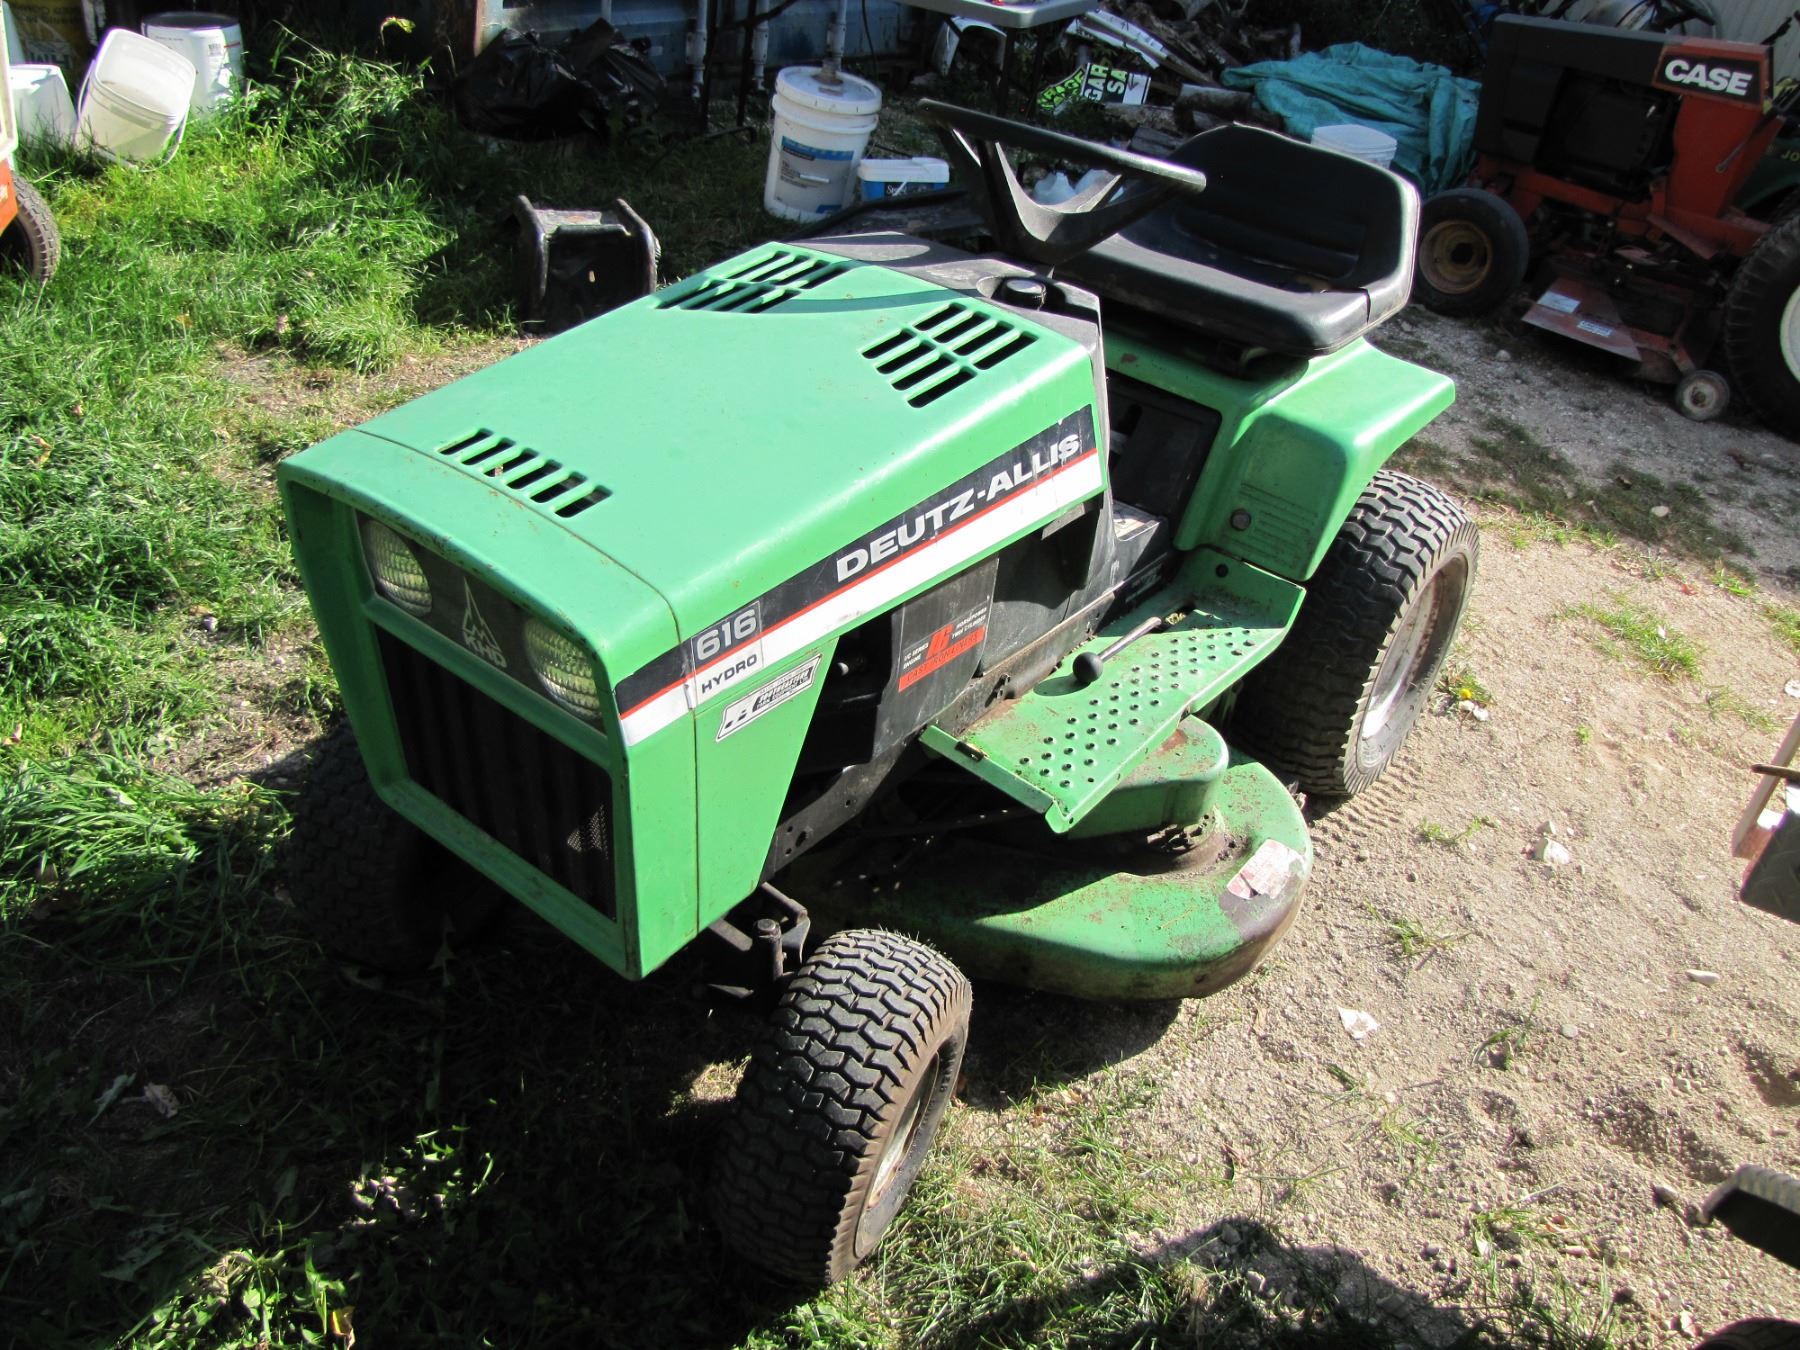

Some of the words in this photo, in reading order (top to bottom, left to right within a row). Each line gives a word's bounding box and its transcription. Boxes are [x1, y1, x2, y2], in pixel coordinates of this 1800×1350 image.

[1664, 59, 1752, 96] CASE
[836, 433, 1079, 583] DEUTZ-ALLIS
[463, 629, 507, 668] KHD
[697, 608, 757, 660] 616
[702, 653, 757, 693] HYDRO
